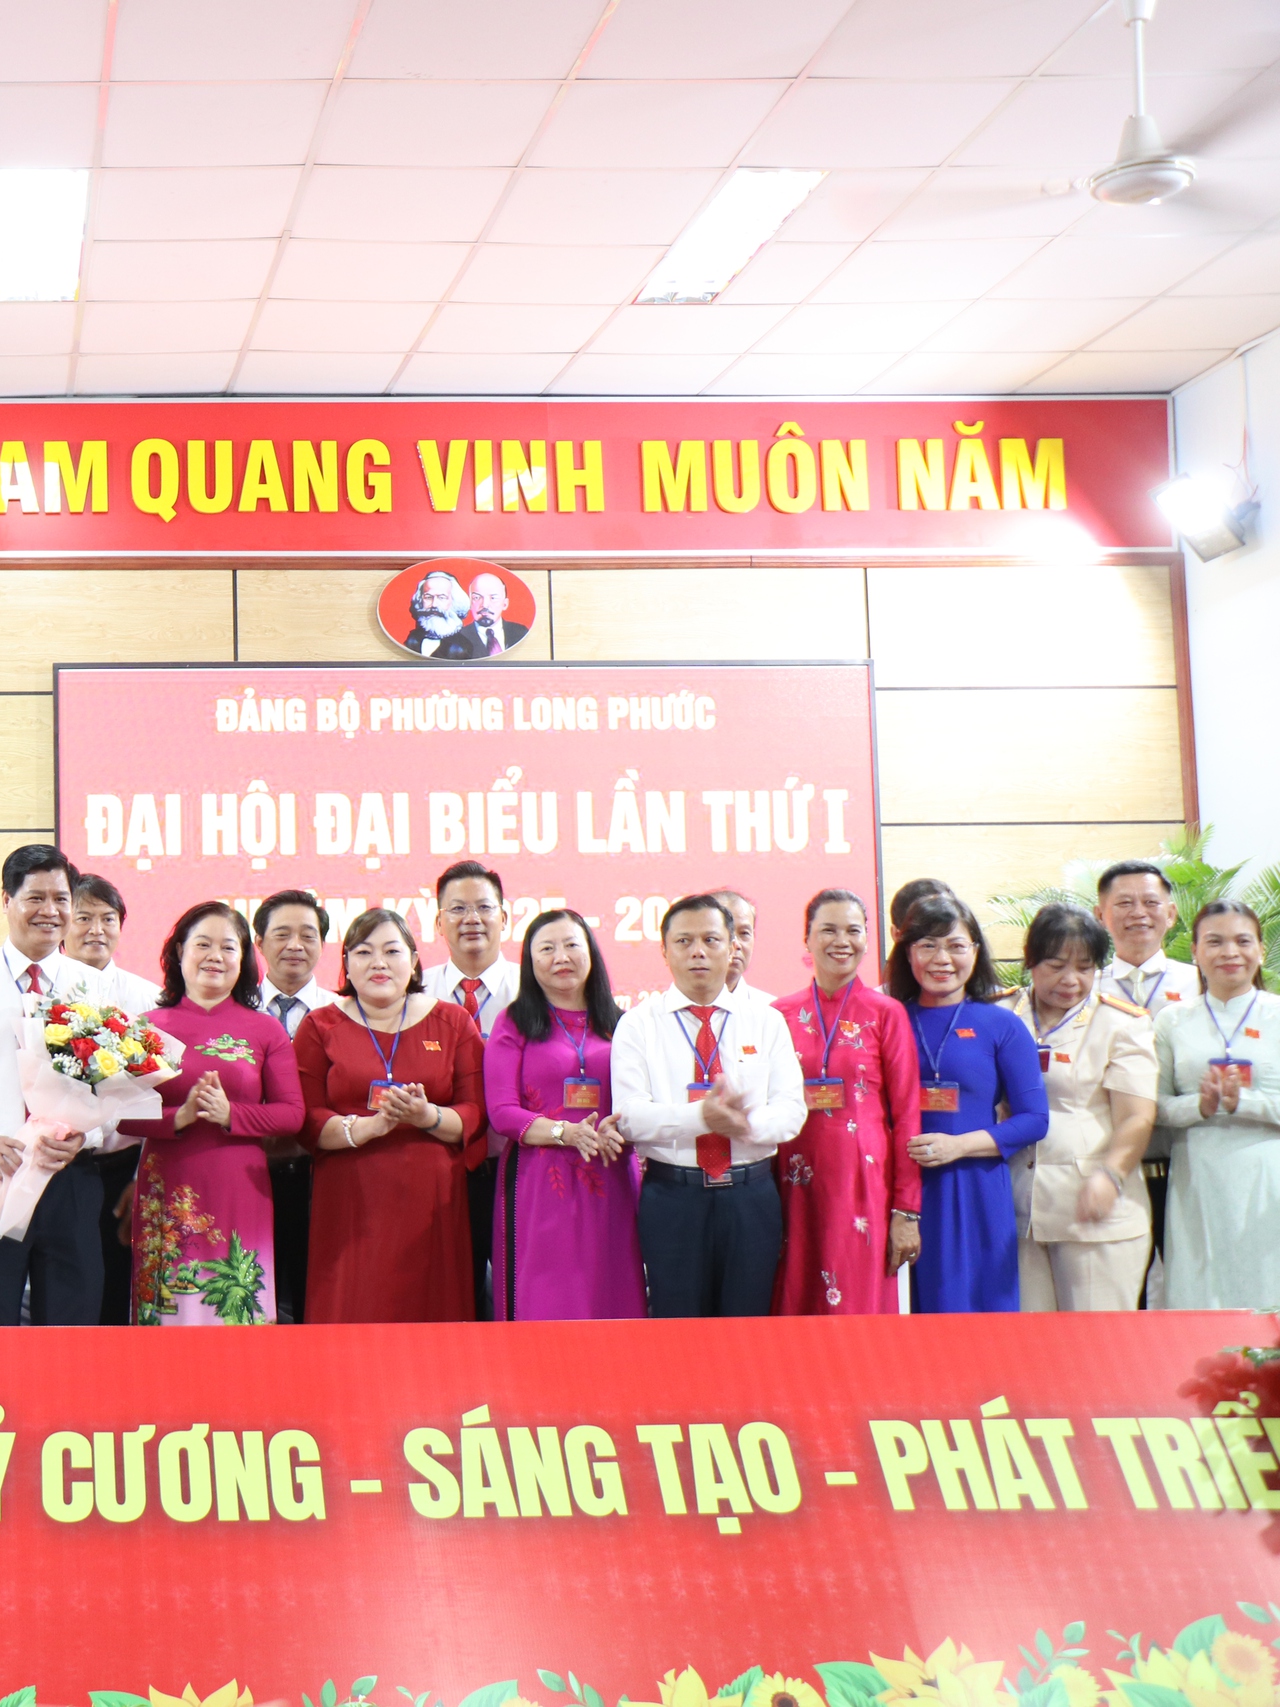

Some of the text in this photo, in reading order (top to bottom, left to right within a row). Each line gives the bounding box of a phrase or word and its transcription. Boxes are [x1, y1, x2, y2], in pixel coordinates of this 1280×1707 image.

[131, 438, 393, 524] QUANG
[416, 439, 606, 514] VINH
[641, 421, 871, 514] MUÔN
[896, 419, 1069, 513] NĂM
[214, 687, 718, 740] ĐẢNG BỘ PHƯỜNG LONG PHƯỚC
[84, 765, 852, 872] ĐẠI HỘI ĐẠI BIỂU LẦN THỨ I
[40, 1422, 327, 1524] CƯƠNG
[404, 1403, 629, 1519] SÁNG
[635, 1421, 802, 1535] TẠO
[868, 1395, 1089, 1511] PHÁT
